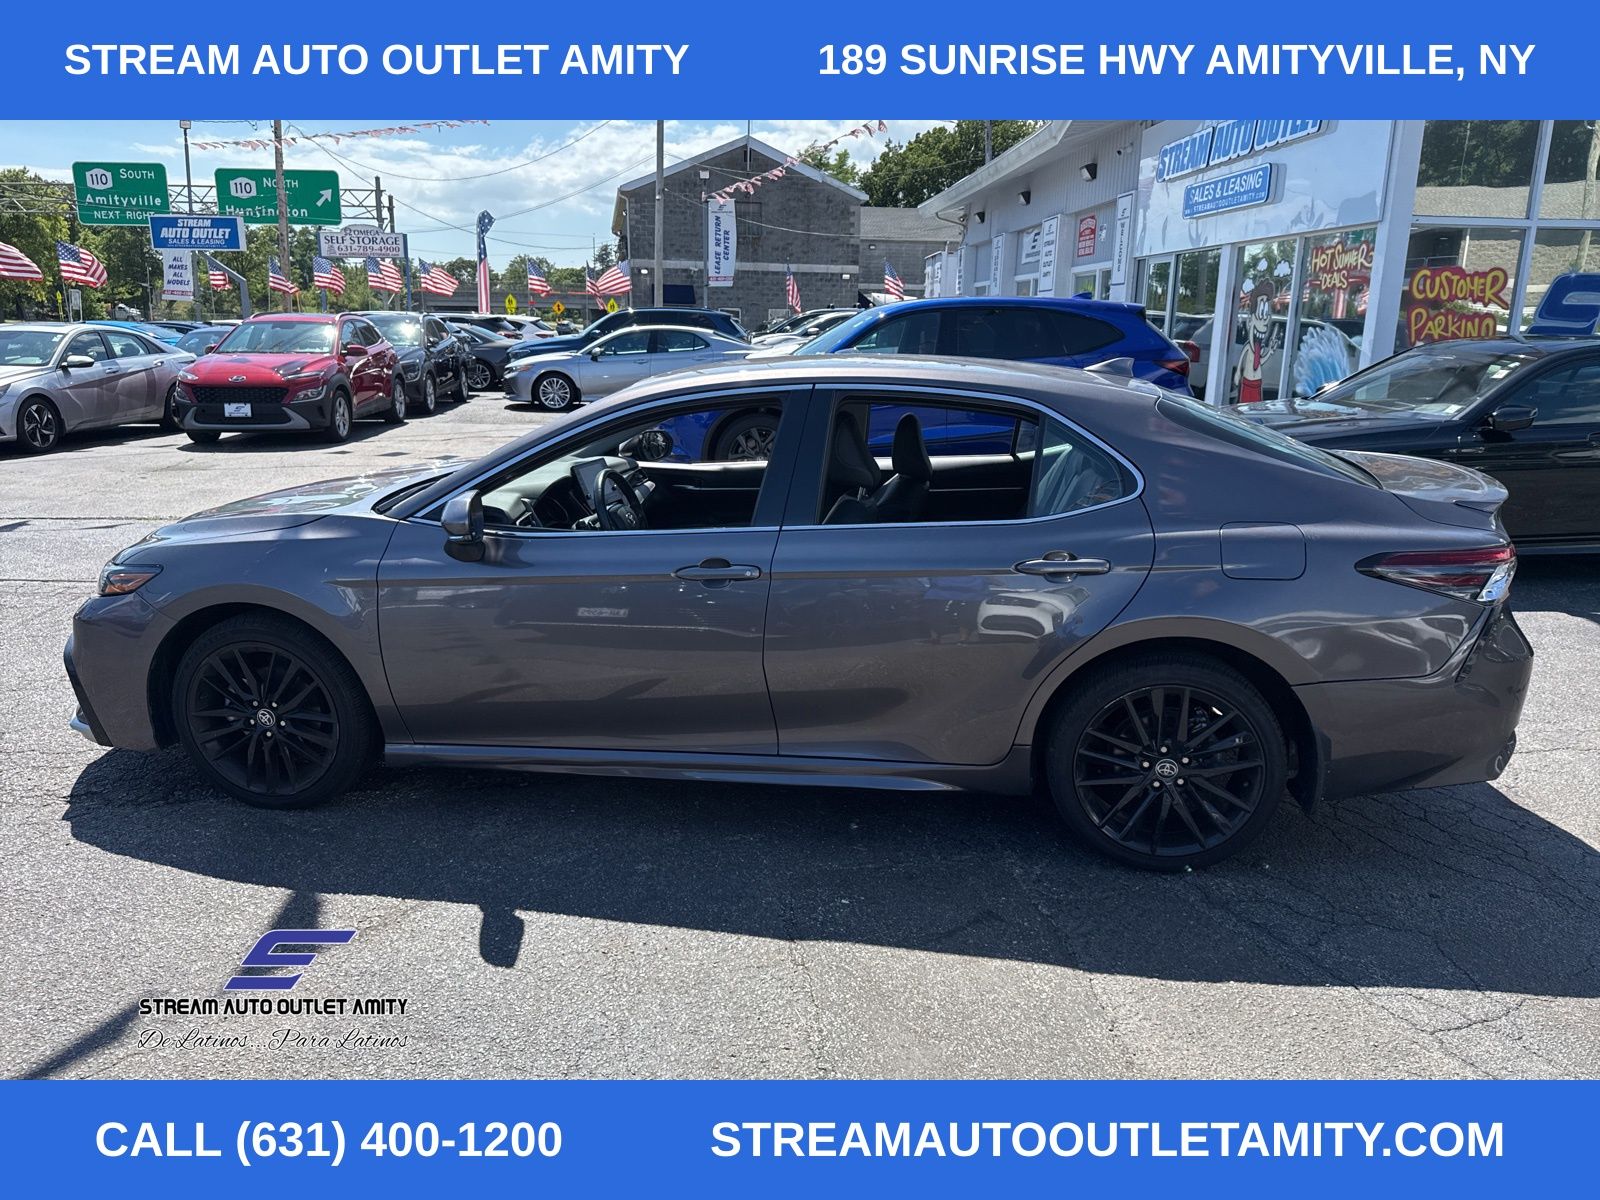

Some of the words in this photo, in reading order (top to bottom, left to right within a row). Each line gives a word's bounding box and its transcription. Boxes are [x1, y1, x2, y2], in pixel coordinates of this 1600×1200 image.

[1157, 128, 1212, 181] STREAM
[1210, 120, 1256, 164] AUTO
[90, 173, 108, 186] 110
[120, 168, 155, 179] SOUTH
[234, 182, 252, 194] 110
[263, 177, 299, 188] NOTH
[1189, 184, 1215, 204] SALES
[1215, 181, 1222, 198] &
[1223, 170, 1263, 196] LEASING
[85, 193, 162, 207] Amityville
[94, 210, 120, 219] NEXT
[177, 218, 212, 227] STREAM
[160, 227, 190, 238] AUTO
[192, 228, 231, 239] OUTLET
[353, 229, 380, 237] OMEGA
[714, 215, 722, 247] RETURN
[324, 235, 347, 245] SELF
[350, 236, 400, 246] STORAGE
[337, 245, 401, 253] 631-789-4900
[714, 250, 722, 275] LEASE
[1312, 249, 1334, 272] HOT
[1321, 270, 1347, 290] DEALS
[1412, 269, 1509, 310] CUSTOMER
